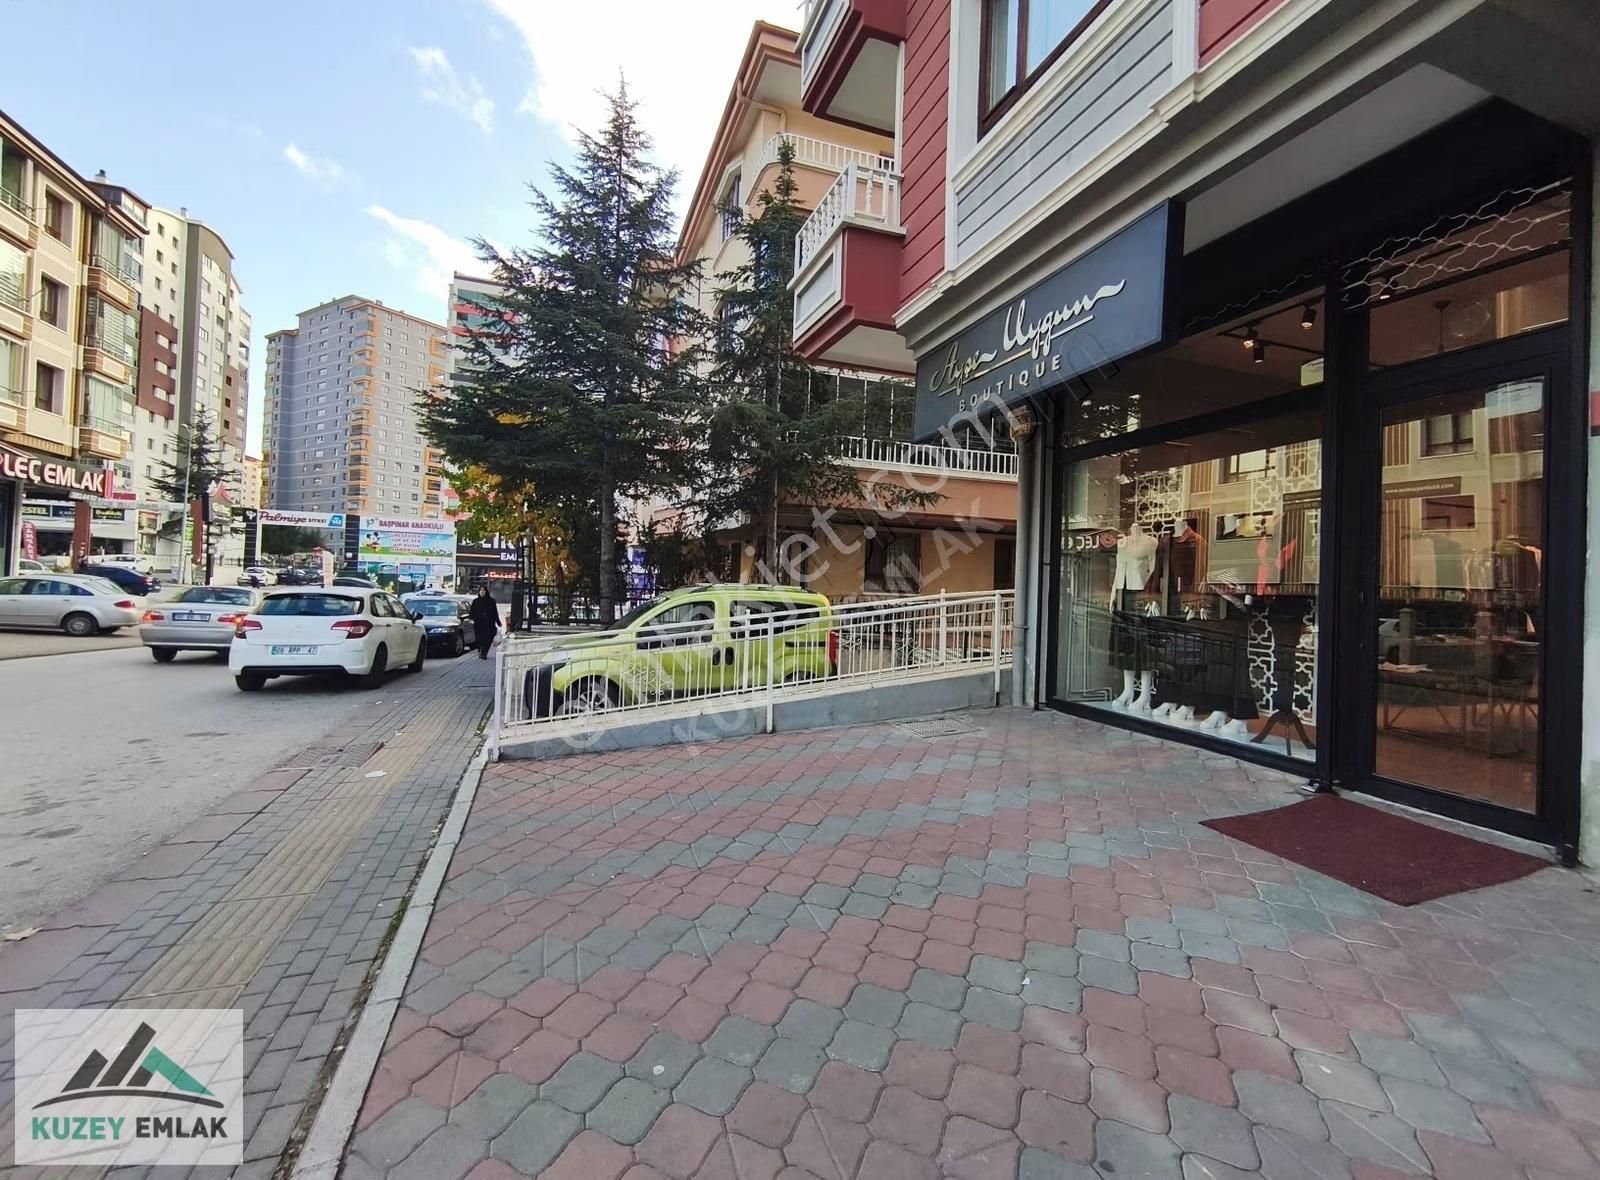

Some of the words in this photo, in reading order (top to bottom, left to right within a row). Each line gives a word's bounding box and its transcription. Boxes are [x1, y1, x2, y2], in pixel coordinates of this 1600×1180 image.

[959, 354, 1062, 411] BOUTIQUE
[0, 452, 41, 484] LEÇ
[44, 463, 104, 493] EMLAK
[259, 511, 307, 525] Palmiye
